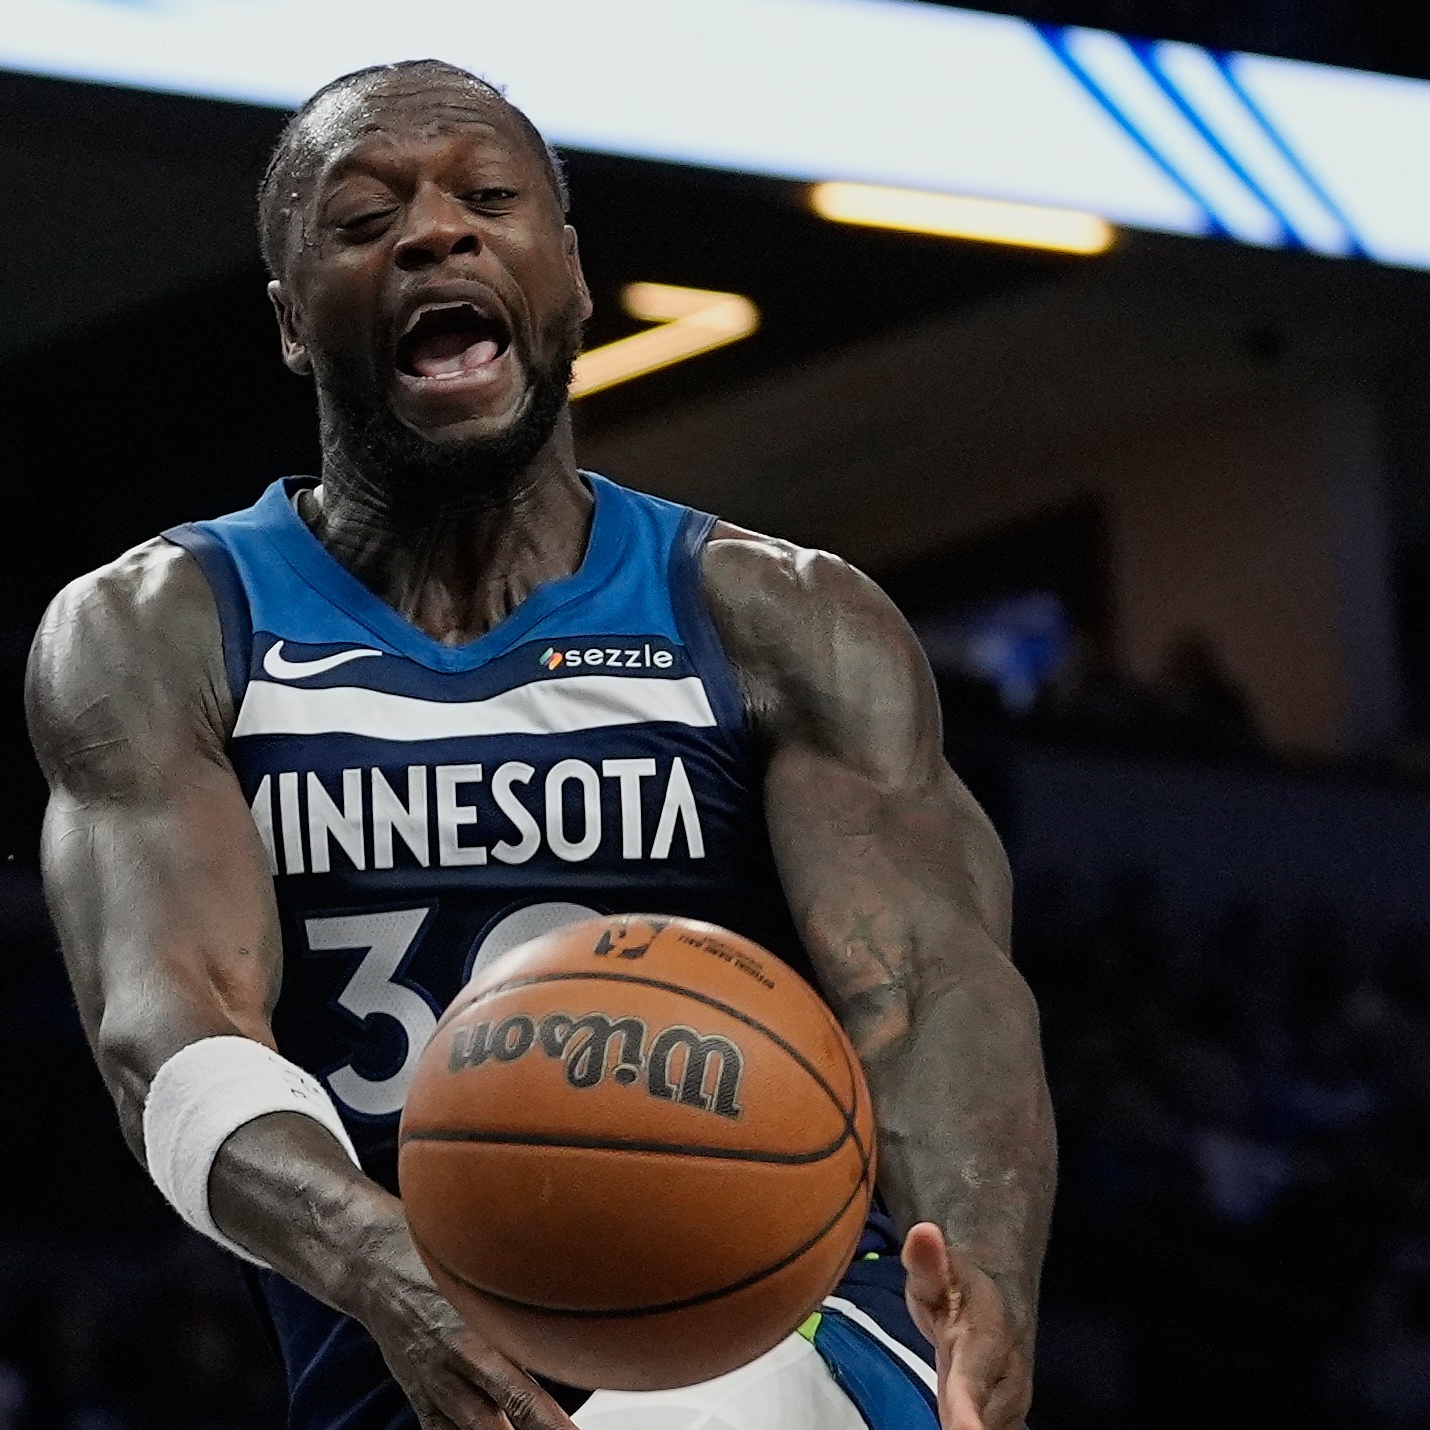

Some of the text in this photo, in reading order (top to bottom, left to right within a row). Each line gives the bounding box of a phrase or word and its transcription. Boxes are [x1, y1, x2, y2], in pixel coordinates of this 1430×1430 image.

[564, 643, 674, 669] sezzle
[304, 901, 606, 1116] 3
[447, 1010, 744, 1121] Wilson
